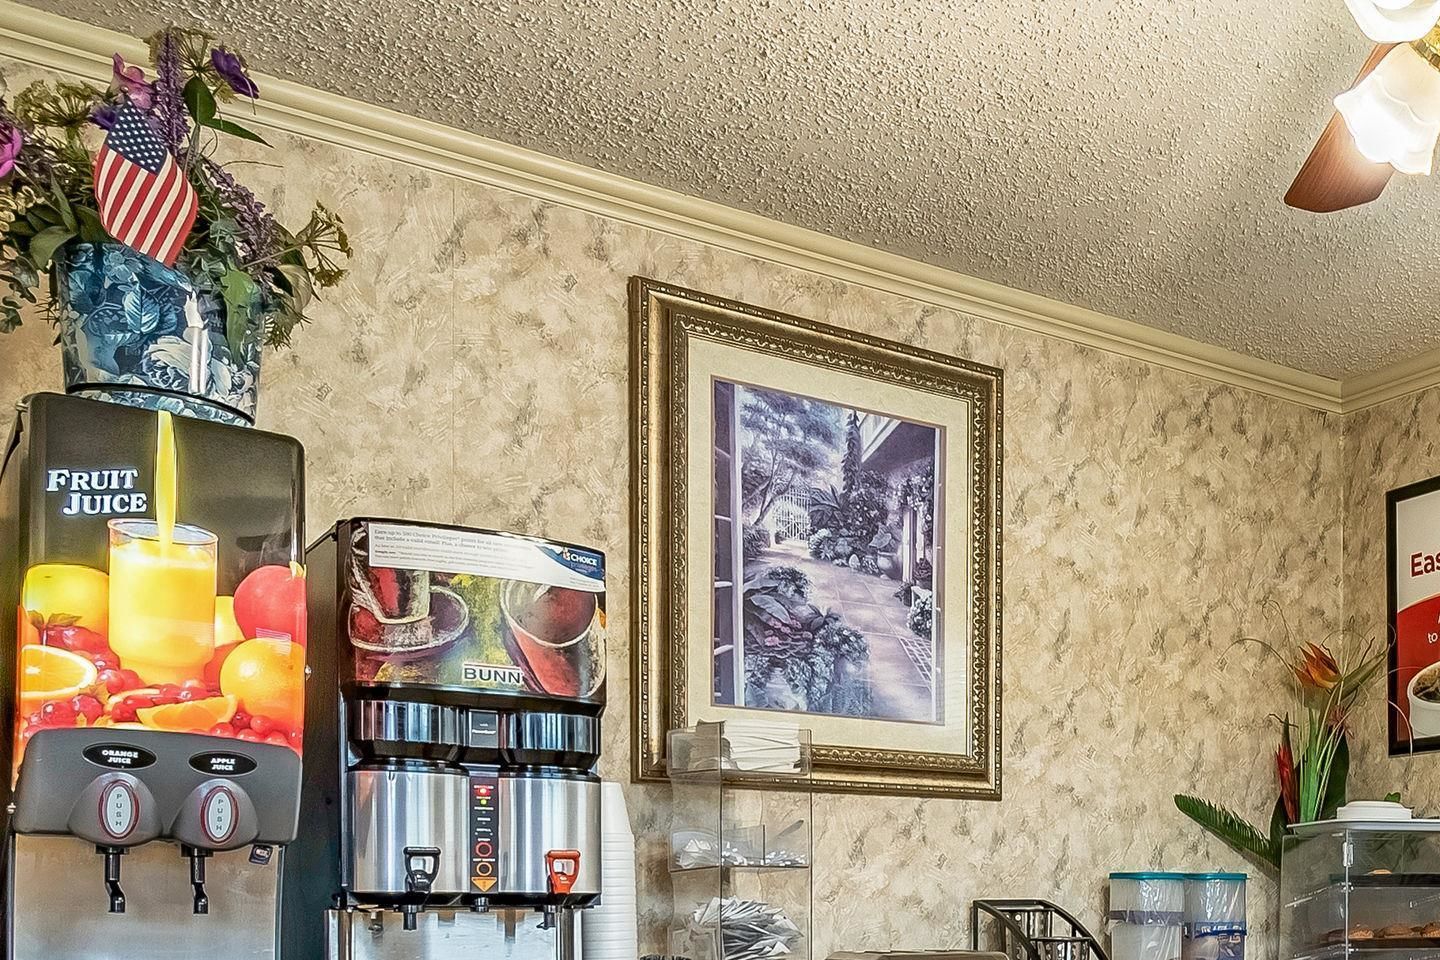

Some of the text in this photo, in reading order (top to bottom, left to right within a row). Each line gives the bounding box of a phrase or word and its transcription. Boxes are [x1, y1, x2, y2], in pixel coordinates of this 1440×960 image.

[46, 468, 139, 492] FRUIT
[62, 492, 147, 515] JUICE
[570, 553, 597, 566] CHOICE
[1427, 632, 1438, 643] to
[464, 667, 520, 684] BUNN
[102, 749, 139, 758] ORANGE
[107, 756, 132, 765] JUICE
[210, 757, 236, 765] APPLE
[211, 763, 234, 771] JUICE
[115, 793, 123, 827] PUSH
[215, 799, 224, 831] PUSH
